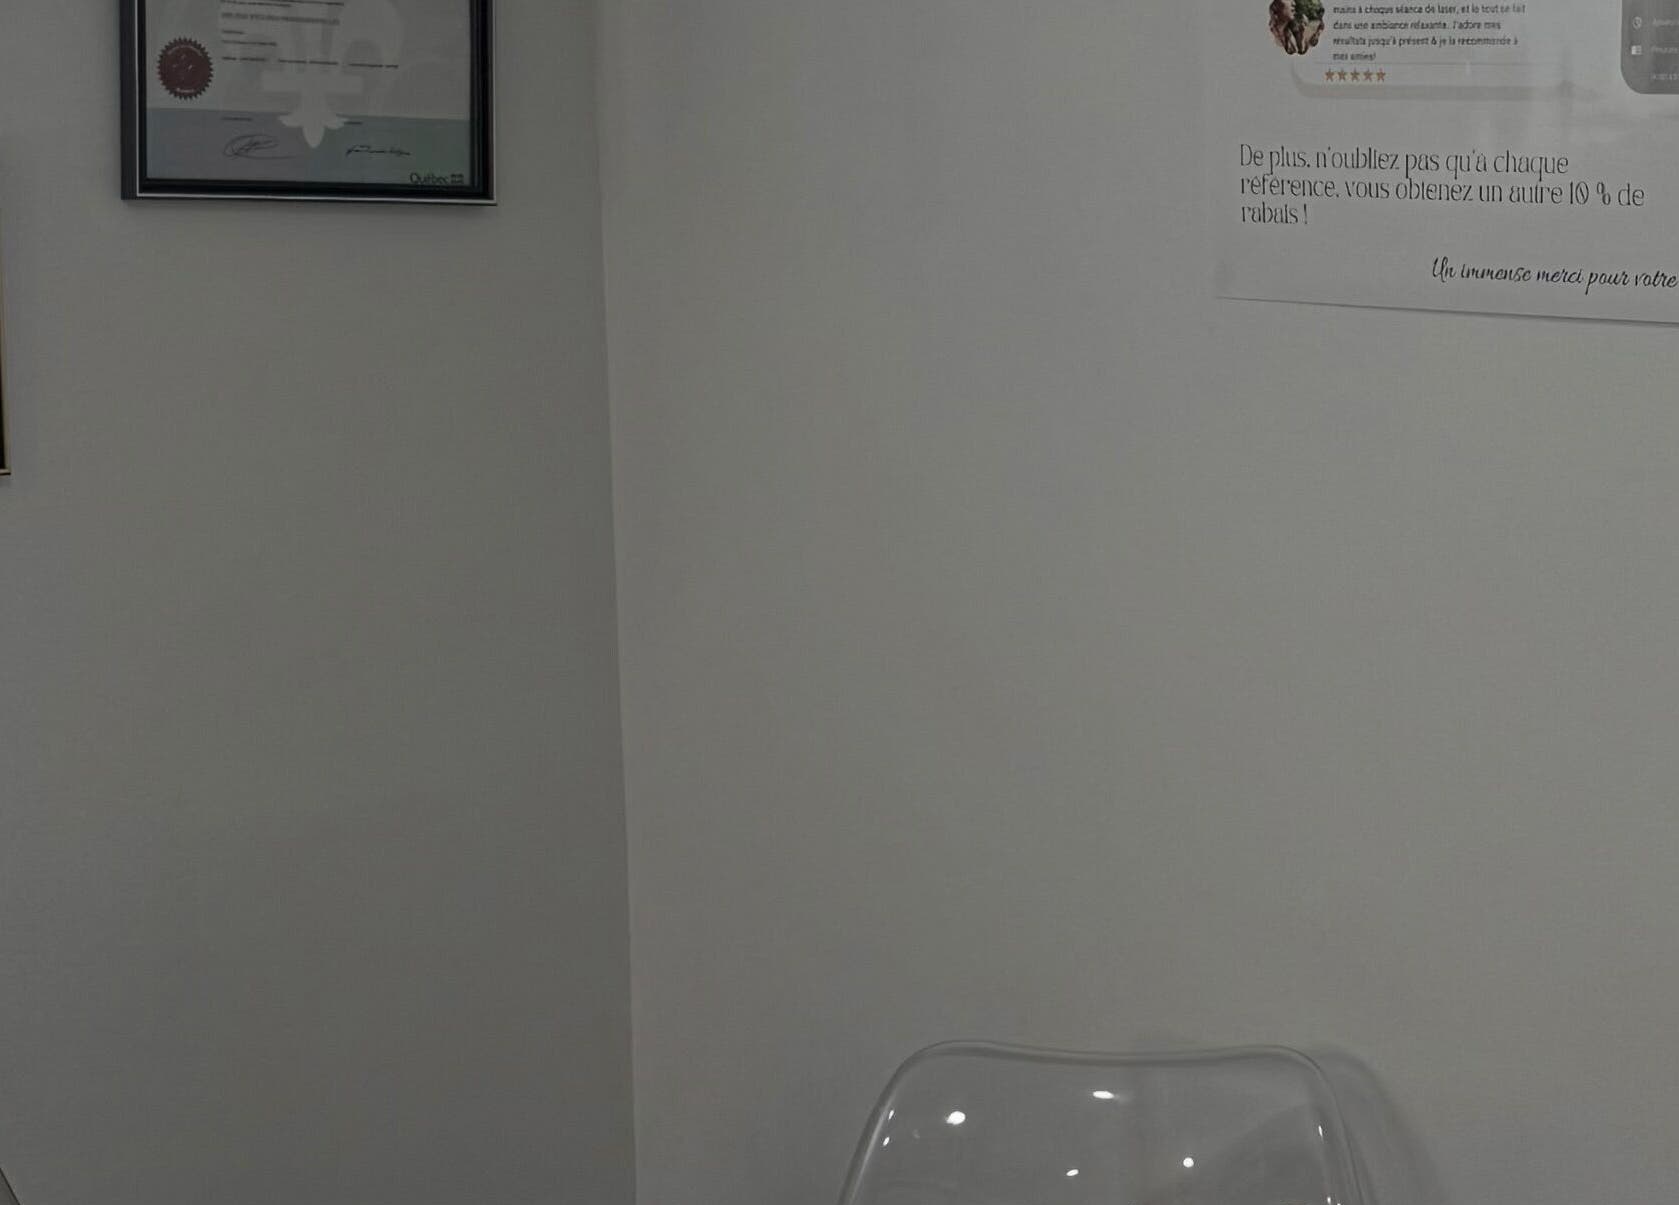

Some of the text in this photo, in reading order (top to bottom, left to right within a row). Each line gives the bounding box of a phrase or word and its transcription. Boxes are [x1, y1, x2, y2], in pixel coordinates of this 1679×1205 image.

[1240, 143, 1264, 167] De
[1316, 146, 1400, 171] n'oubliez
[1405, 152, 1440, 179] pas
[1493, 149, 1569, 182] chaque
[1345, 180, 1390, 200] vous
[1395, 177, 1473, 202] obtenez
[1479, 184, 1503, 203] un
[1509, 182, 1563, 205] autre
[1569, 180, 1590, 206] 10
[1596, 181, 1611, 206] %
[1617, 182, 1645, 207] de
[1241, 201, 1299, 225] rabais
[1432, 256, 1456, 283] Un
[1460, 263, 1532, 283] immense
[1536, 268, 1584, 285] merci
[1584, 270, 1629, 296] pour
[1635, 270, 1678, 288] votre
